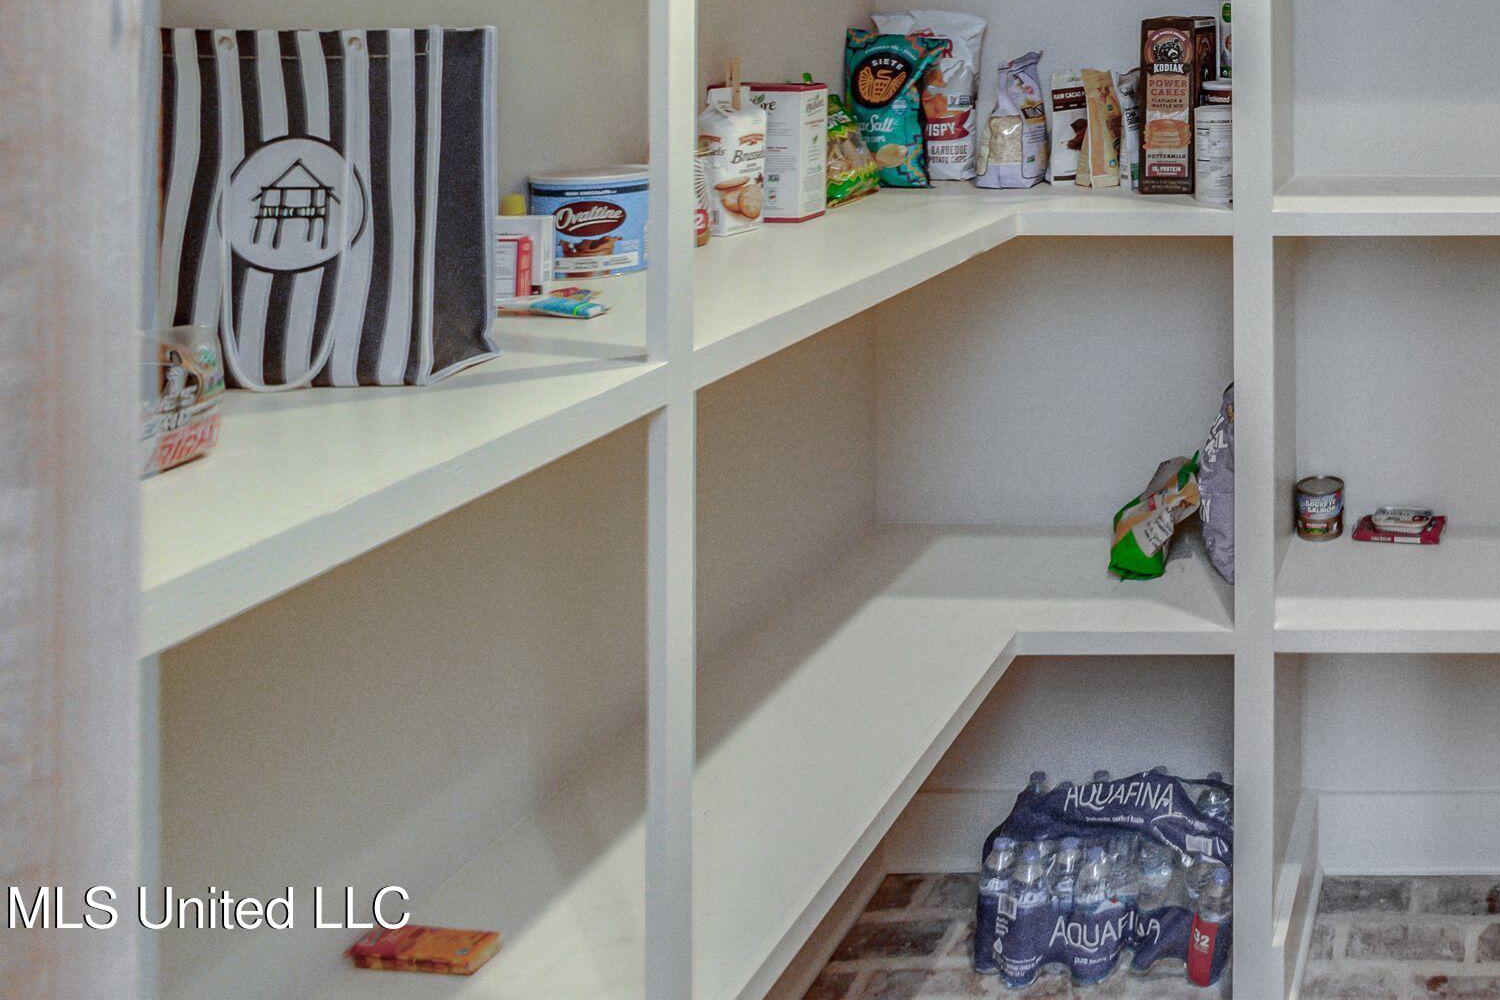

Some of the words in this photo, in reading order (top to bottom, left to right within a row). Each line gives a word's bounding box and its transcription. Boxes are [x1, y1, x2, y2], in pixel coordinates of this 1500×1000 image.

[871, 58, 904, 70] SIETE
[1153, 63, 1185, 74] KODIAK
[1149, 79, 1188, 88] POWER
[1150, 88, 1186, 96] CAKES
[867, 114, 895, 133] Salt
[926, 122, 956, 137] ISPY
[930, 144, 968, 156] BARBEQUE
[556, 206, 624, 229] Ovaltine
[1063, 782, 1174, 815] AQUAFINA
